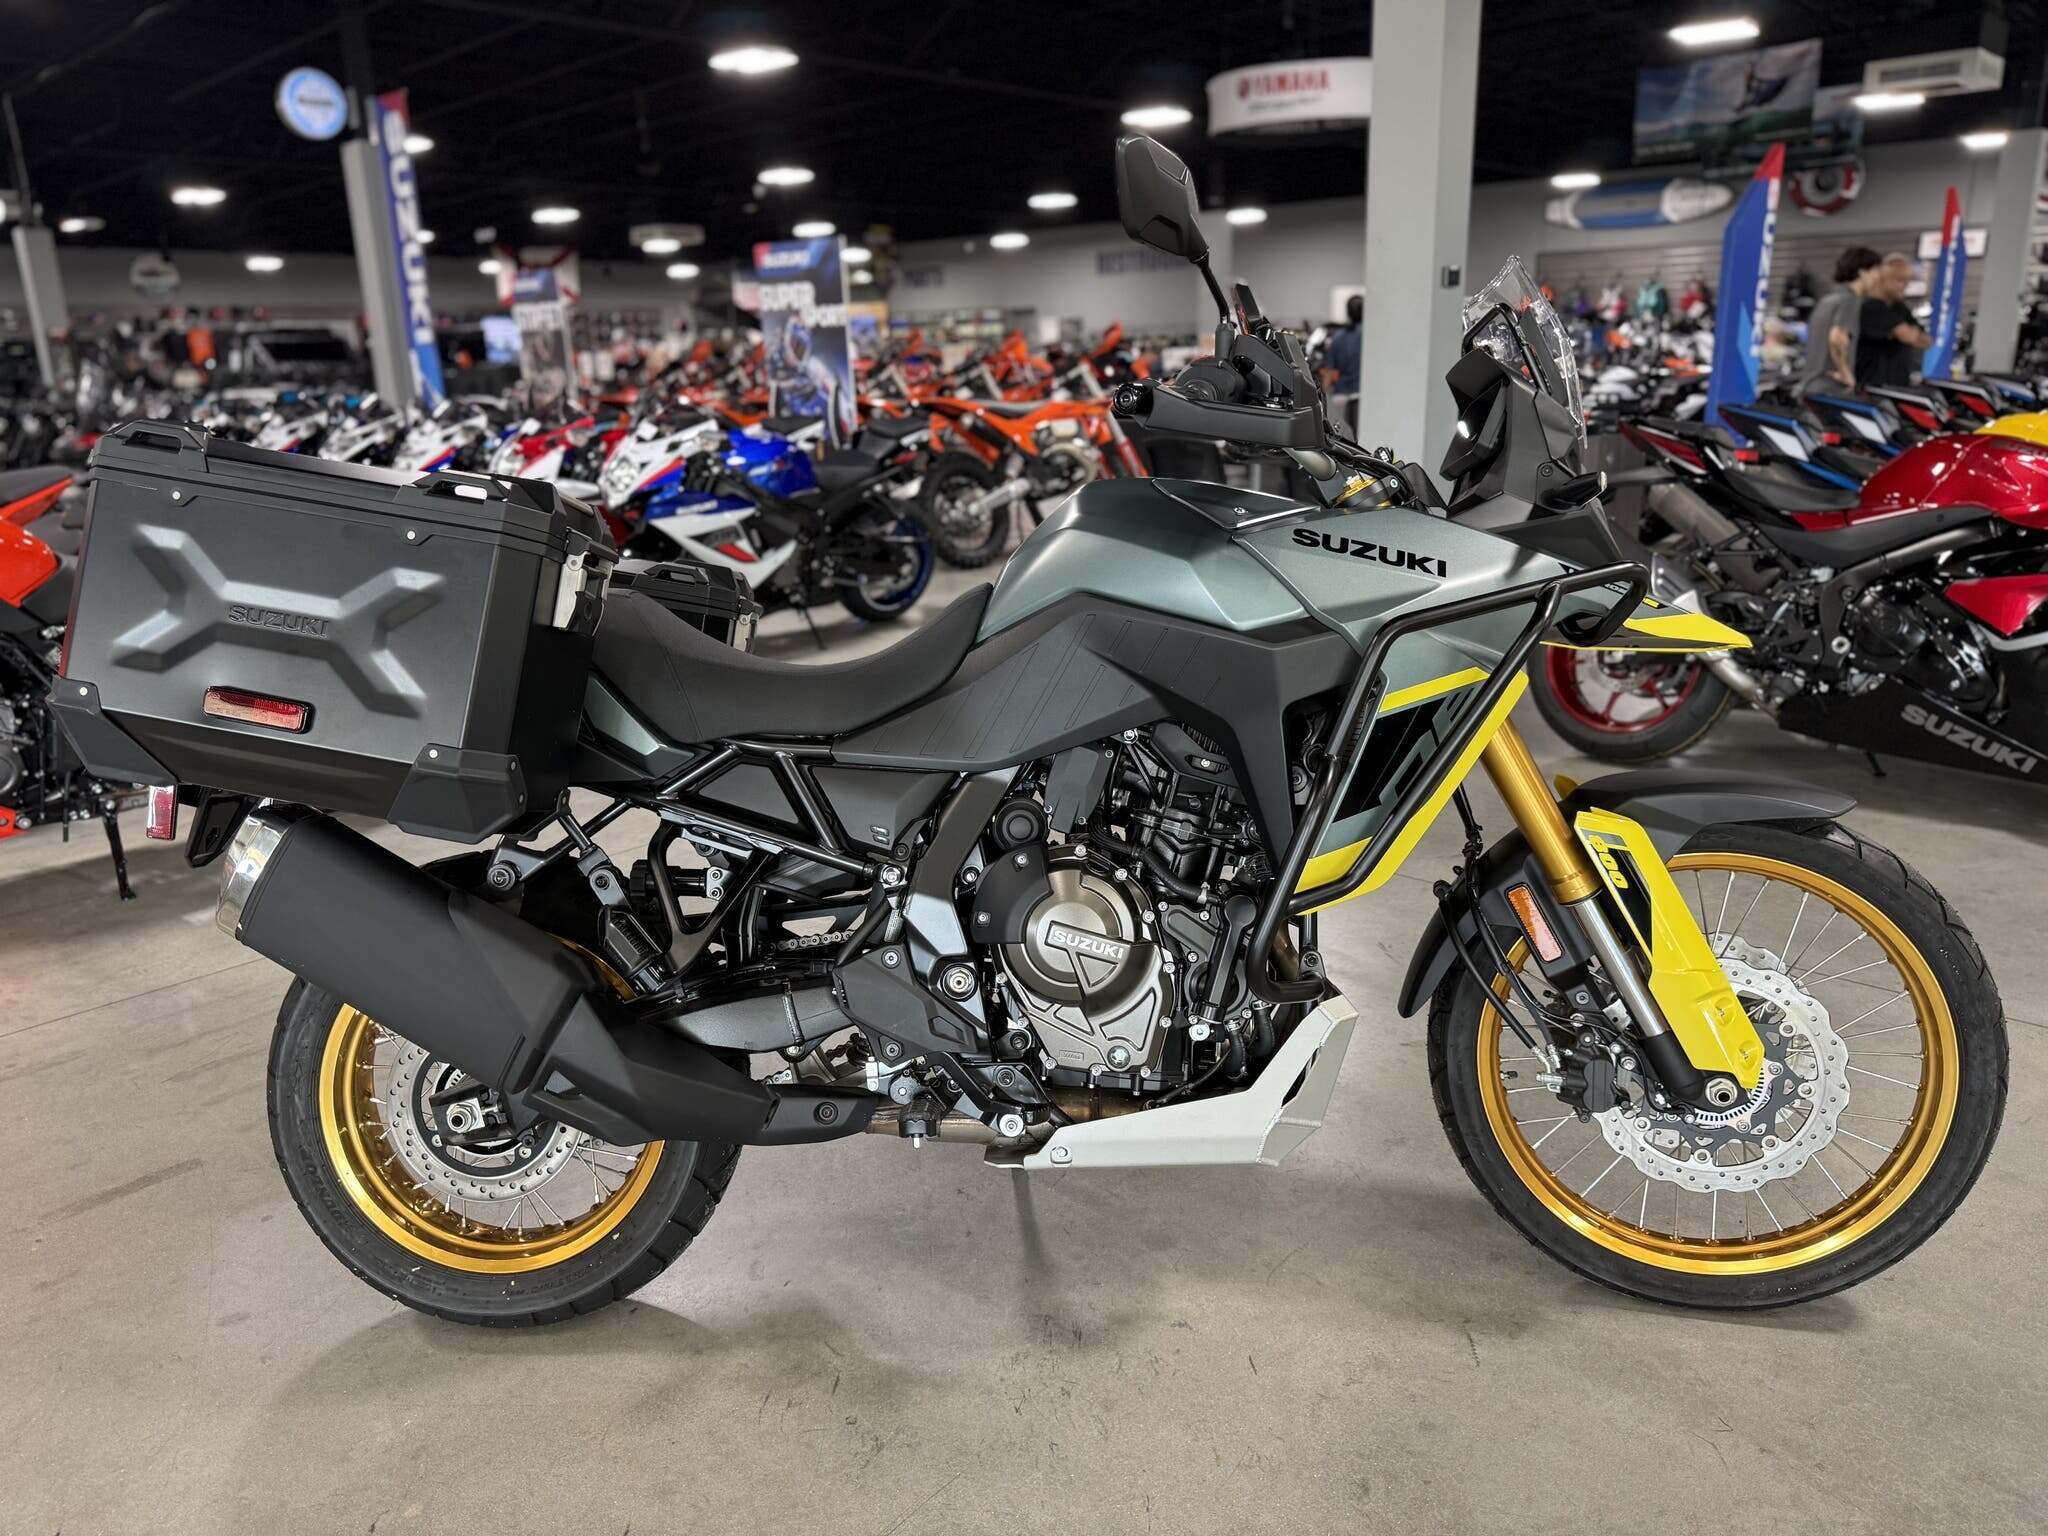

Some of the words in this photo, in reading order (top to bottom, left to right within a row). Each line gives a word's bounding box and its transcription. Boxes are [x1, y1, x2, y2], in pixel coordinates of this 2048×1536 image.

[1292, 528, 1447, 578] SUZUKI
[227, 604, 330, 639] SUZUKI
[1900, 703, 2038, 774] SUZUKI
[1588, 835, 1629, 889] 800
[1053, 930, 1124, 959] SUZUKI
